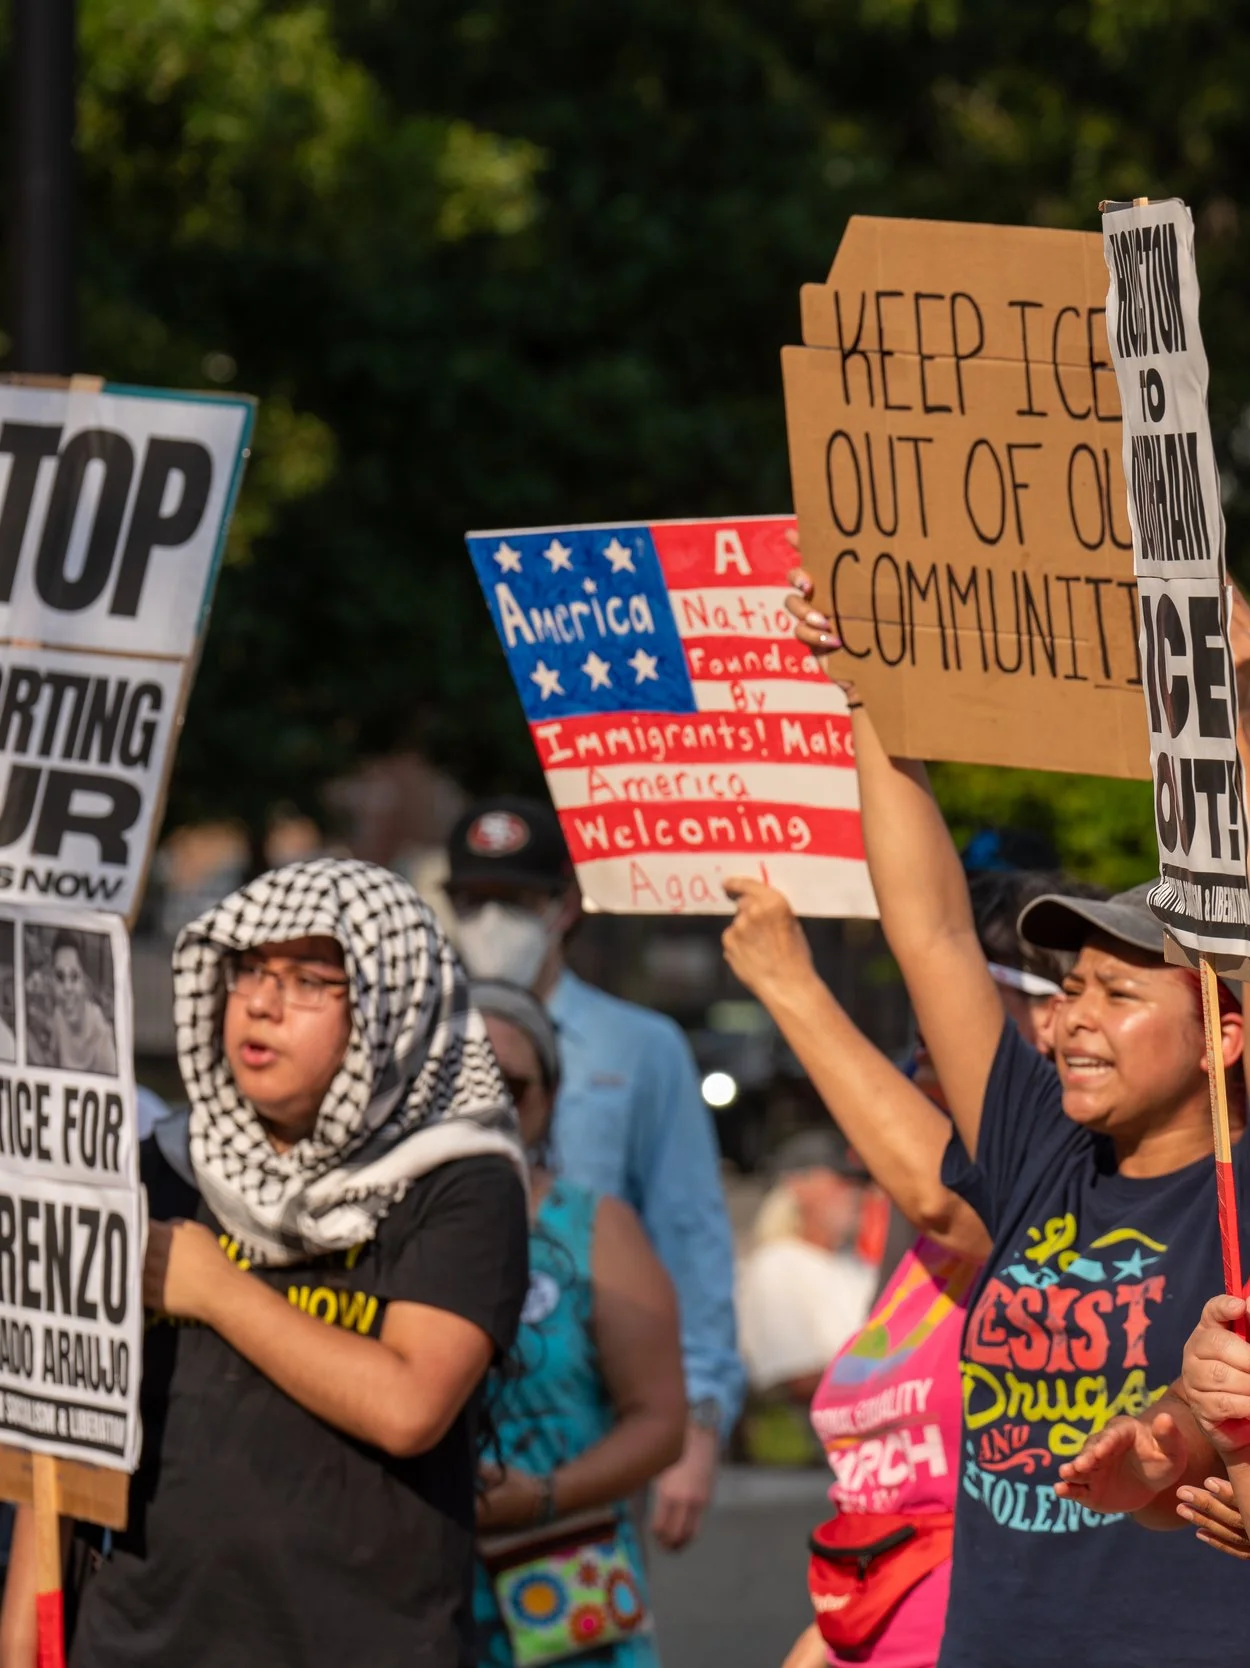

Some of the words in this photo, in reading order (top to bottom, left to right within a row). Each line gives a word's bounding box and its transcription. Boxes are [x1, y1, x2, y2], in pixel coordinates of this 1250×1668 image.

[1109, 222, 1187, 359] HOUSTON
[834, 290, 985, 416] KEEP
[1008, 300, 1123, 422] ICE
[1139, 367, 1166, 423] TO
[0, 421, 213, 618] TOP
[826, 429, 934, 539] OUT
[963, 438, 1043, 546] OF
[1067, 443, 1133, 551] OU
[1131, 432, 1211, 561] DURHAM
[714, 530, 752, 575] A
[494, 577, 655, 648] America
[682, 596, 795, 634] Natio
[830, 549, 1143, 686] COMMUNITI
[729, 684, 767, 711] By
[1141, 593, 1232, 739] ICE
[0, 664, 163, 772] RTING
[537, 720, 767, 762] Immigrants!
[586, 768, 751, 801] America
[1156, 751, 1241, 861] OUT!
[574, 806, 812, 850] Welcoming
[20, 866, 122, 900] NOW
[63, 1087, 124, 1172] FOR
[42, 1327, 130, 1397] ARAUJO
